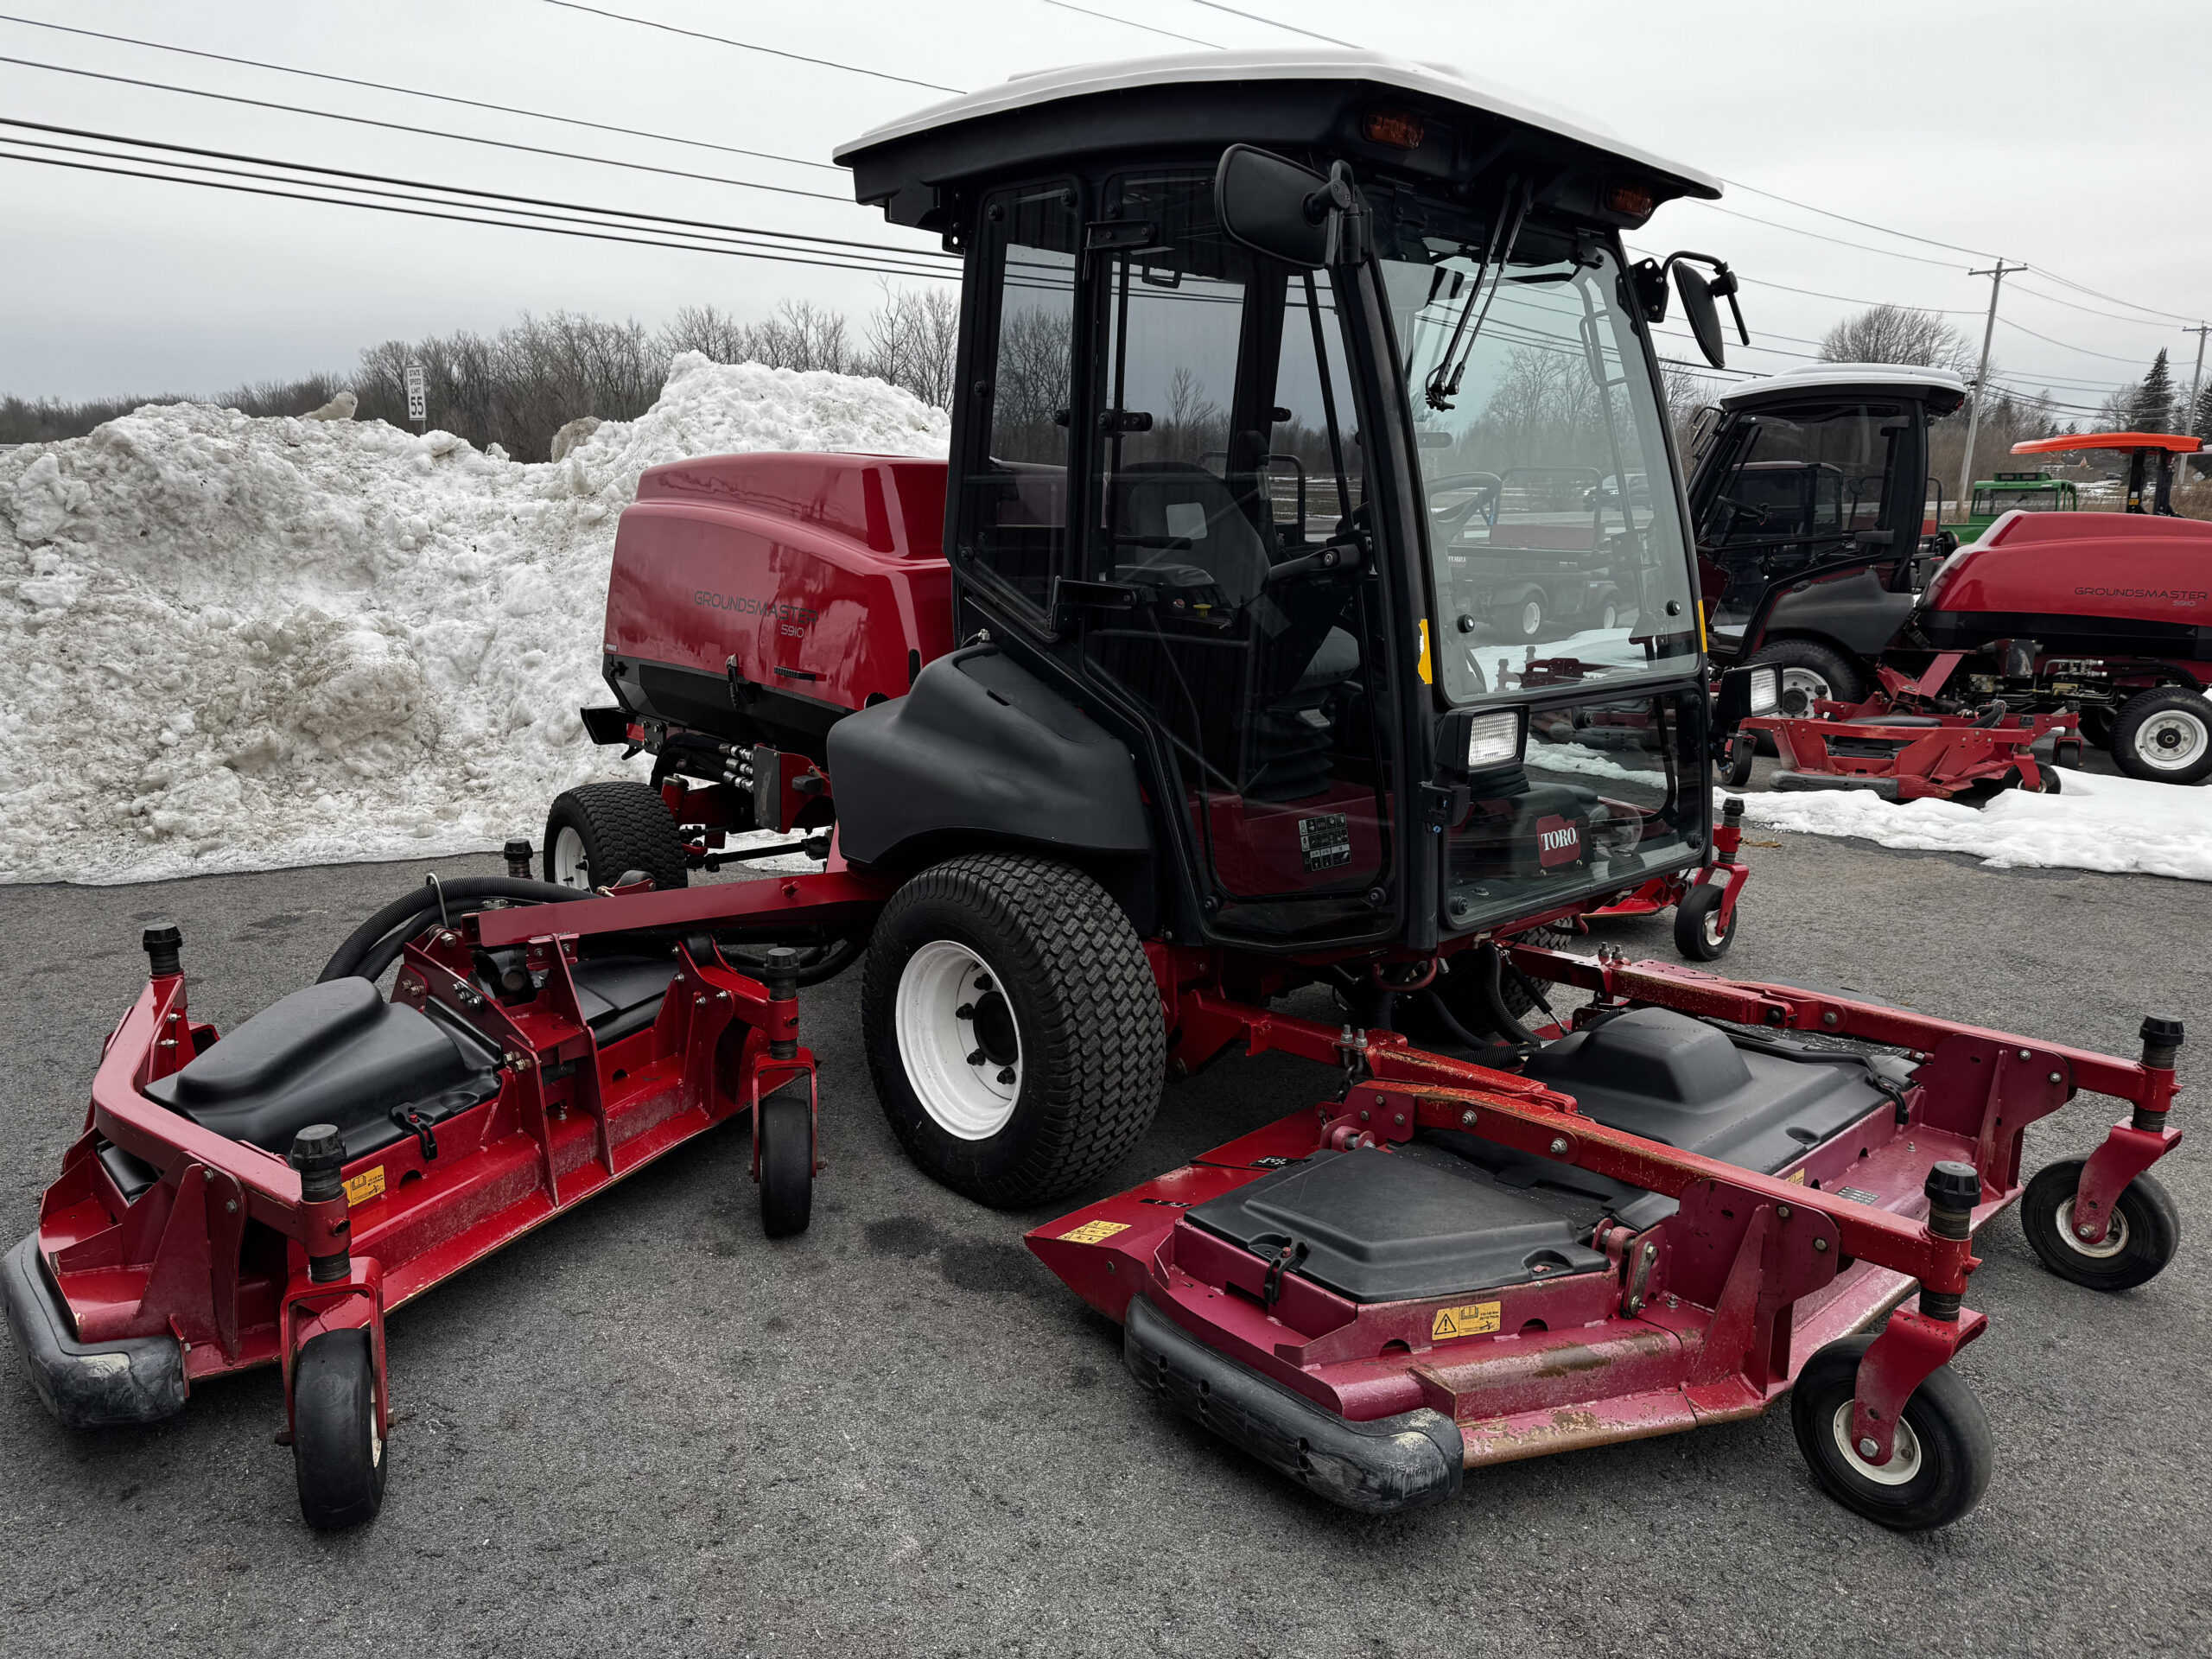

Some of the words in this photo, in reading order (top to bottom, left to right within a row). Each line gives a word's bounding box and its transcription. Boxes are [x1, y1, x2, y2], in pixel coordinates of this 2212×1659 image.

[410, 397, 424, 416] 55
[2075, 587, 2209, 600] GROUNDSMASTER
[694, 591, 817, 626] GROUNDSMASTER
[780, 624, 804, 639] 5910
[1541, 827, 1577, 851] TORO
